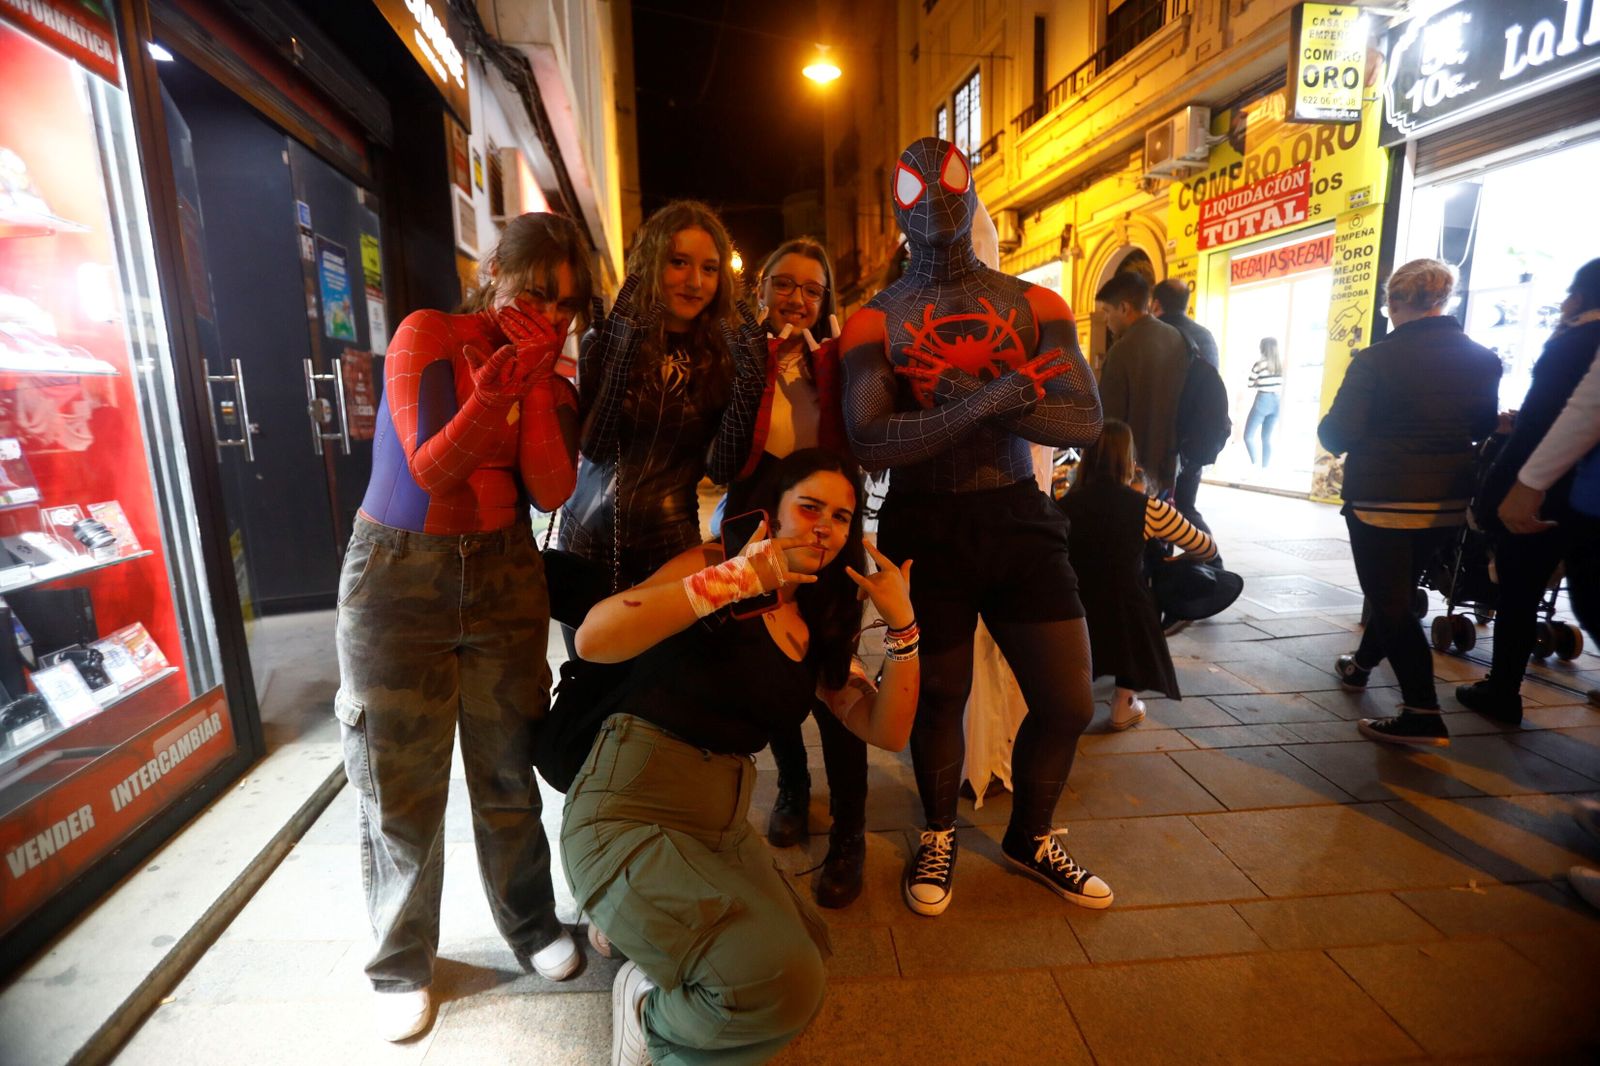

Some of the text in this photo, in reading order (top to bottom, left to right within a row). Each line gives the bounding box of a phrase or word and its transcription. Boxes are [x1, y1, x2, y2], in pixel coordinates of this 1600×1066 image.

[1303, 47, 1362, 63] COMPRO
[1302, 64, 1360, 90] ORO
[1302, 95, 1318, 105] 622
[1178, 121, 1362, 211] COMPRO ORO
[1203, 169, 1307, 219] LIQUIDACIÓN
[1202, 200, 1306, 247] TOTAL
[1335, 227, 1375, 244] EMPEÑA
[1343, 244, 1374, 262] ORO
[1333, 261, 1372, 276] MEJOR
[1333, 272, 1371, 287] PRECIO
[109, 711, 222, 813] INTERCAMBIAR
[5, 803, 96, 880] VENDER
